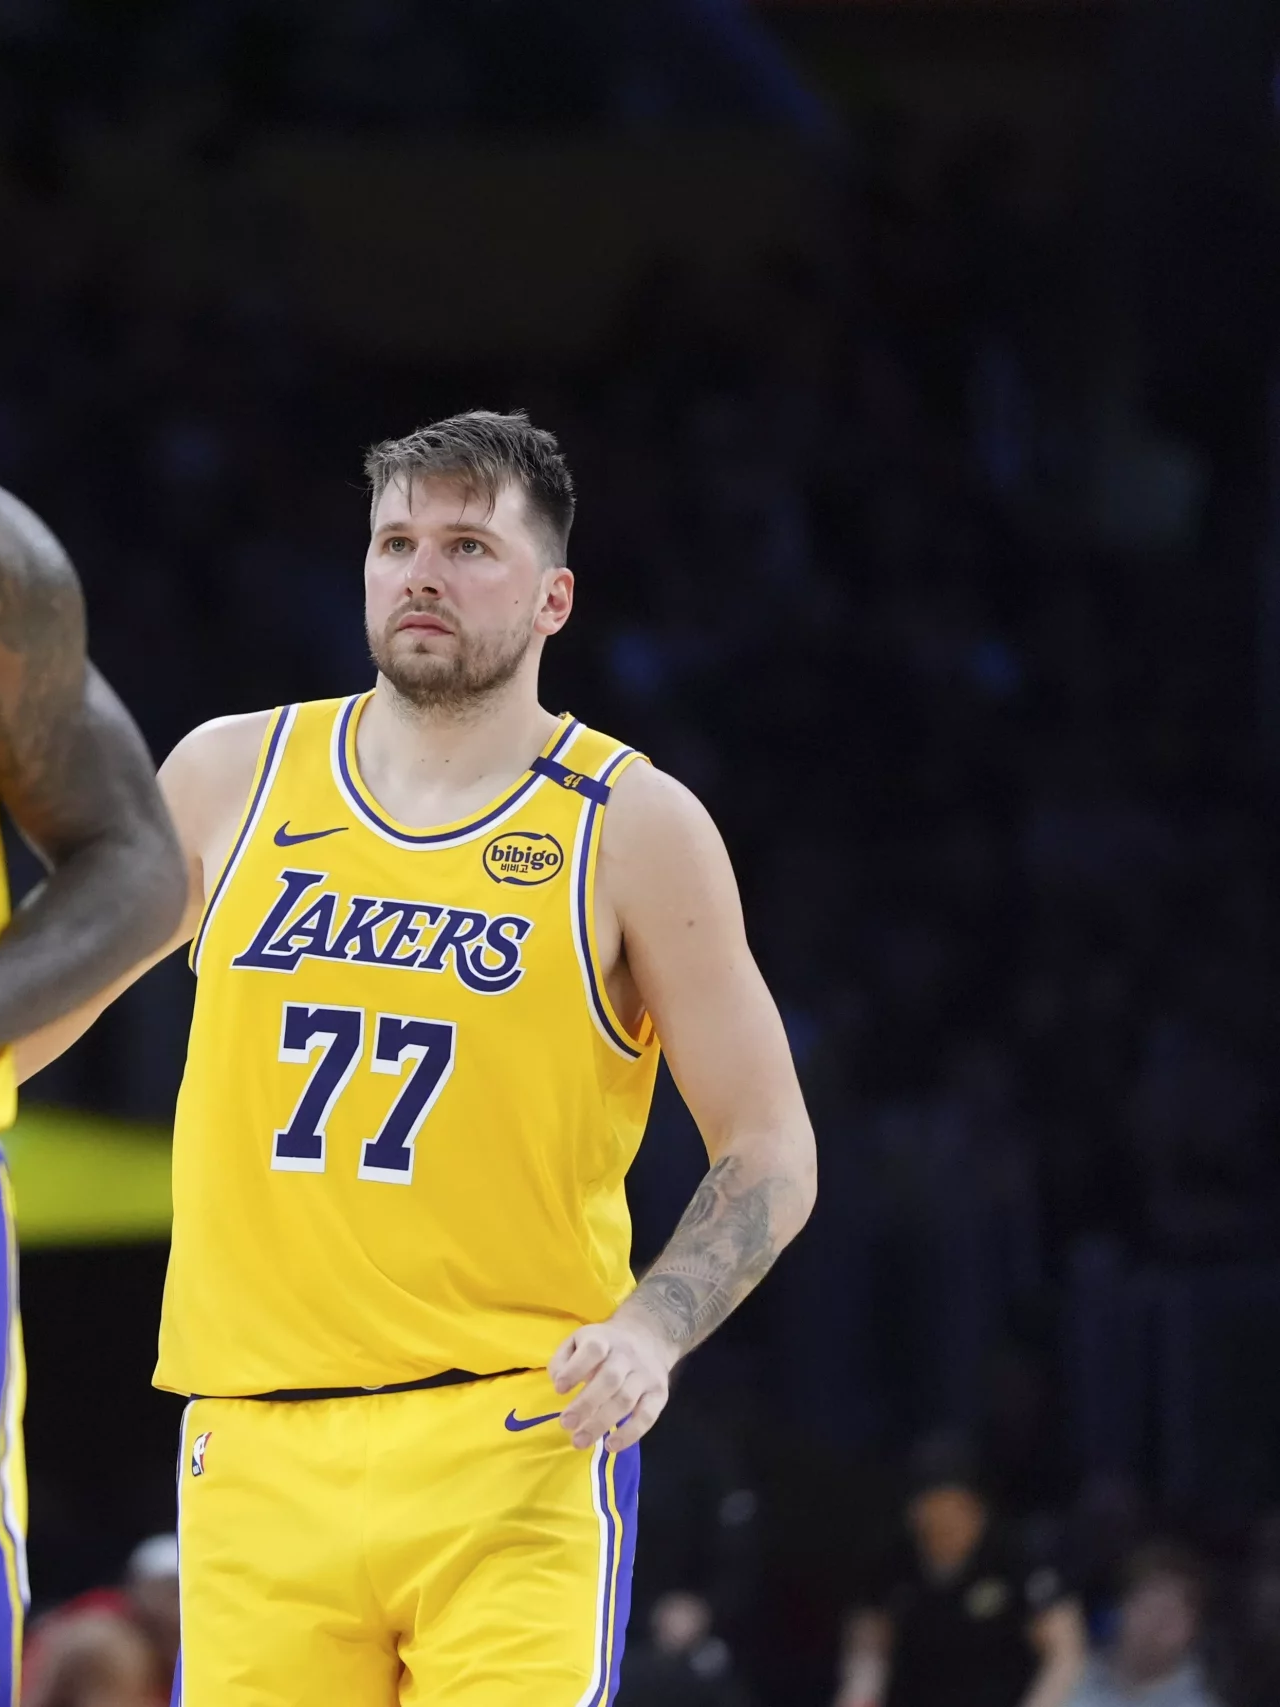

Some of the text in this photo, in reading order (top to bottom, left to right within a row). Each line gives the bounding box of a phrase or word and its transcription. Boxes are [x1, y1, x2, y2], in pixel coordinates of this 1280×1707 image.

[563, 773, 584, 788] 44
[491, 845, 558, 870] bibigo
[500, 863, 529, 873] 비비고
[229, 867, 537, 996] LAKERS
[271, 1001, 457, 1186] 77
